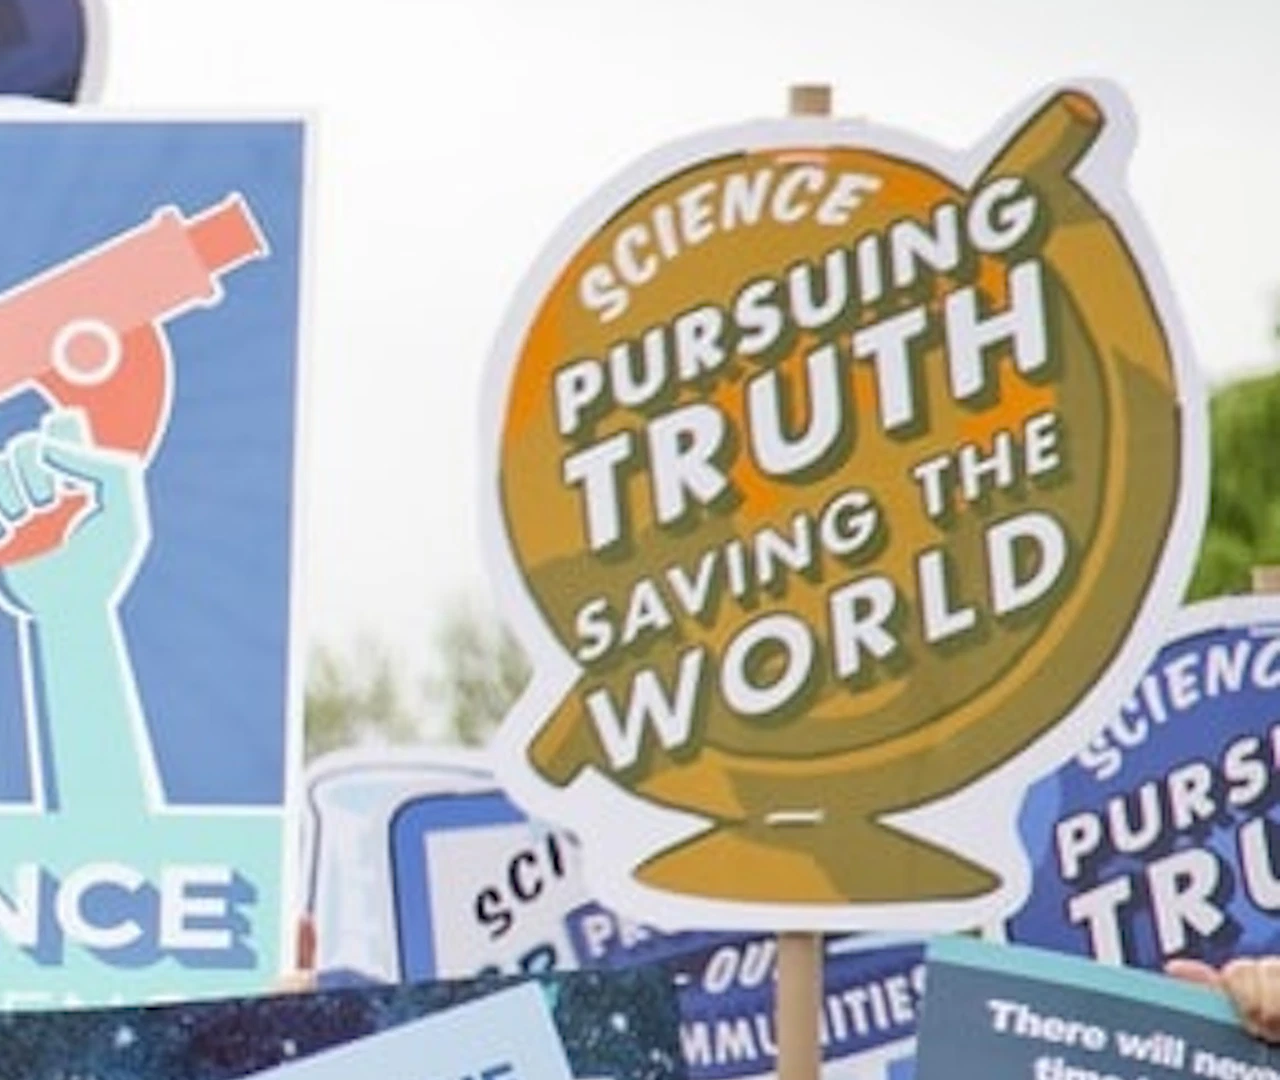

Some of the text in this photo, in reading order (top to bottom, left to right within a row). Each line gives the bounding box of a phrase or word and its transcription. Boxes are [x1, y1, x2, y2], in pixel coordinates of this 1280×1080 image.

[555, 177, 1037, 435] PURSUING
[578, 163, 882, 322] SCIENCE
[564, 260, 1048, 551] TRUTH
[577, 413, 1060, 661] SAVING THE
[586, 511, 1067, 772] WORLD
[1055, 726, 1280, 880] PURS
[987, 998, 1107, 1051] There
[1115, 1029, 1185, 1070] will
